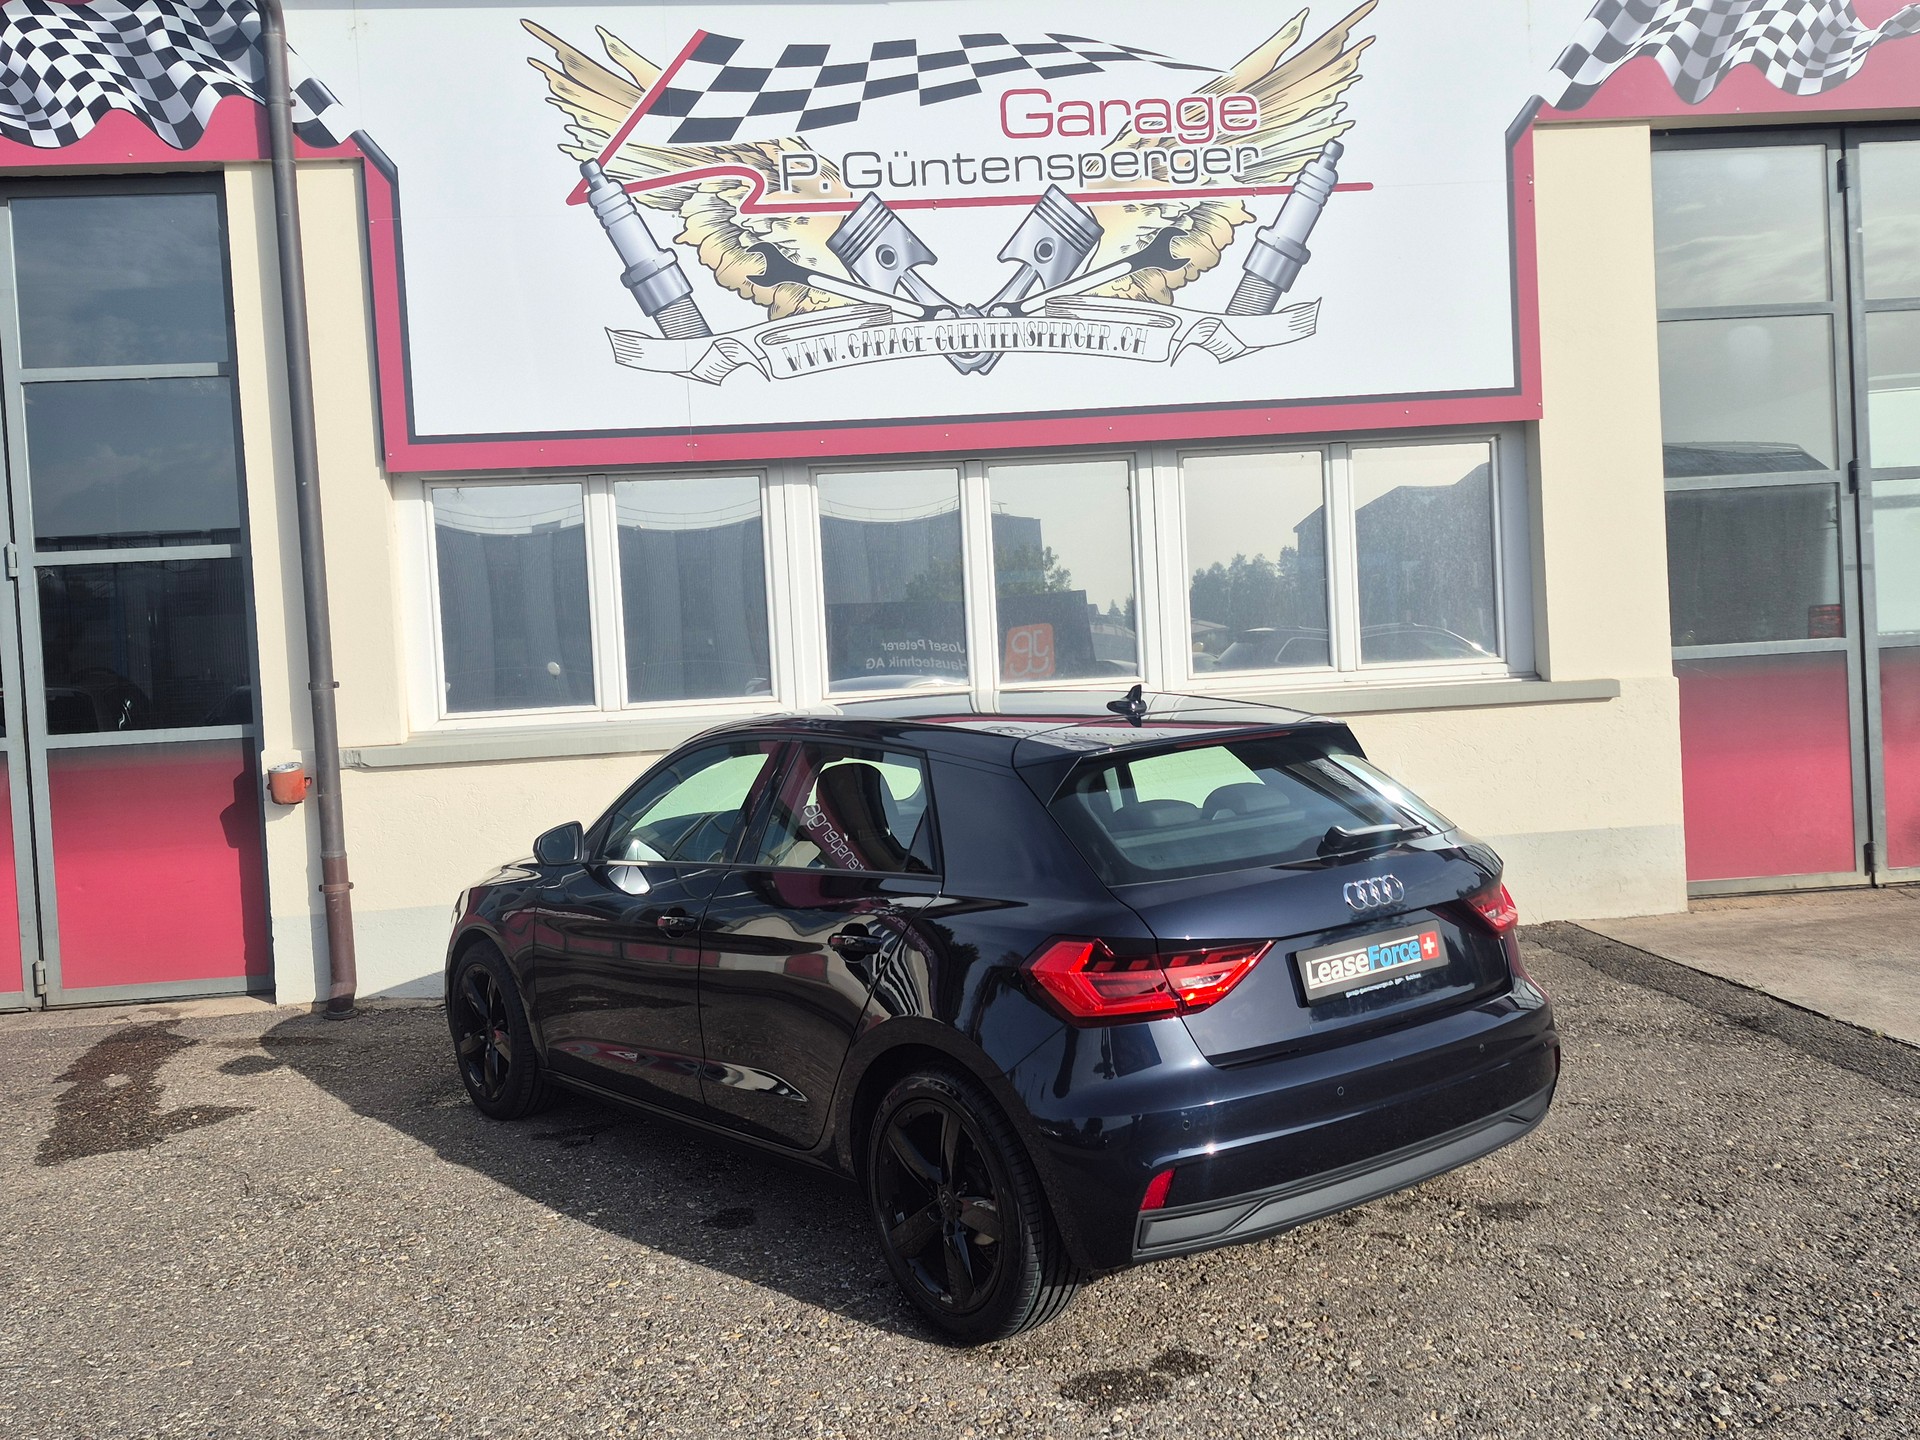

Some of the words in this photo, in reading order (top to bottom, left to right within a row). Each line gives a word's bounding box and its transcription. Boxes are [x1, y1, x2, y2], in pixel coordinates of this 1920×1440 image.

[1000, 88, 1258, 144] Garage
[781, 153, 829, 191] P.
[842, 146, 1260, 189] Güntensperger
[782, 320, 1150, 371] WWW.GARAGE-GUENTENSPERGER.CH
[1305, 941, 1421, 985] LeaseForce
